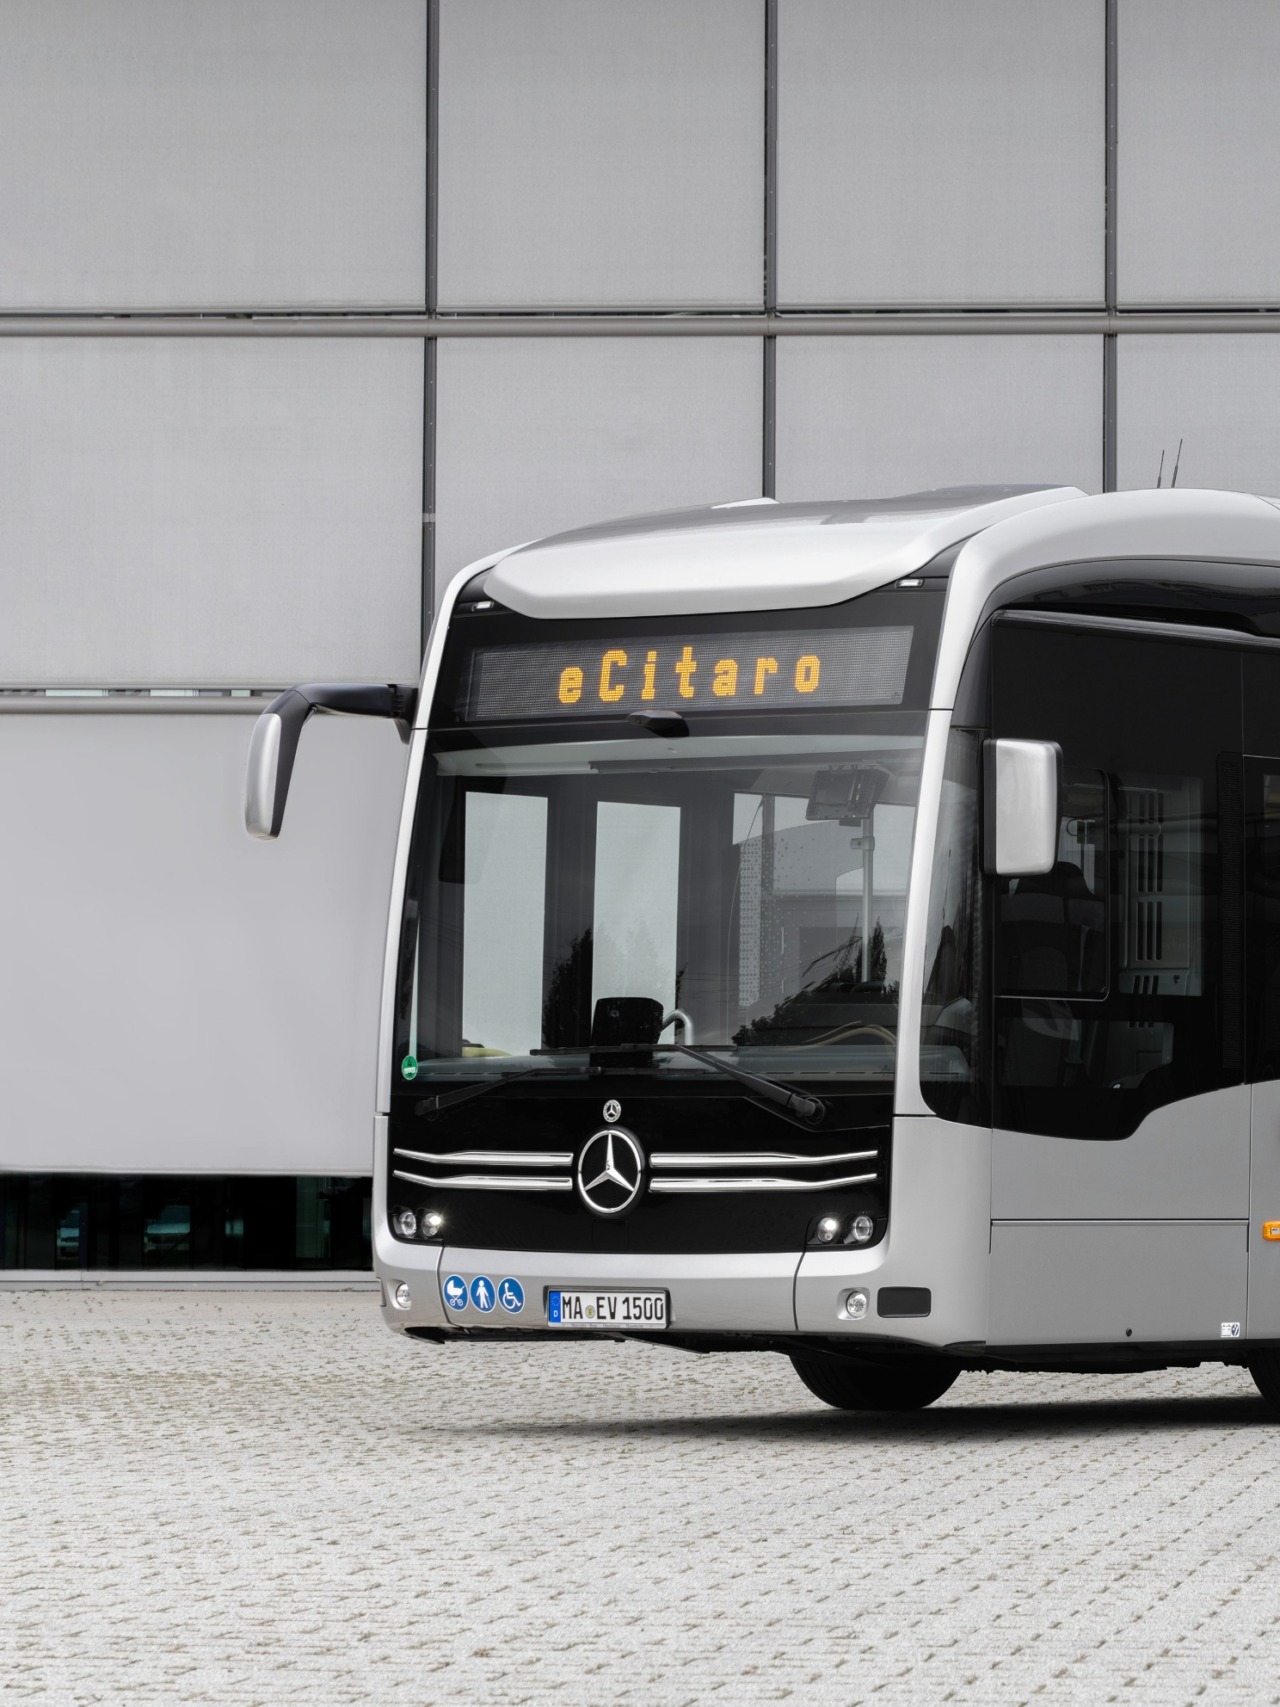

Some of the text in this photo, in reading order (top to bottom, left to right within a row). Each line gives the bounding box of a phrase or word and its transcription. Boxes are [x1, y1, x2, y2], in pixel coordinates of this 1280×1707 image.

[558, 646, 820, 703] eCitaro
[553, 1310, 559, 1318] D
[562, 1296, 664, 1321] MA EV 1500
